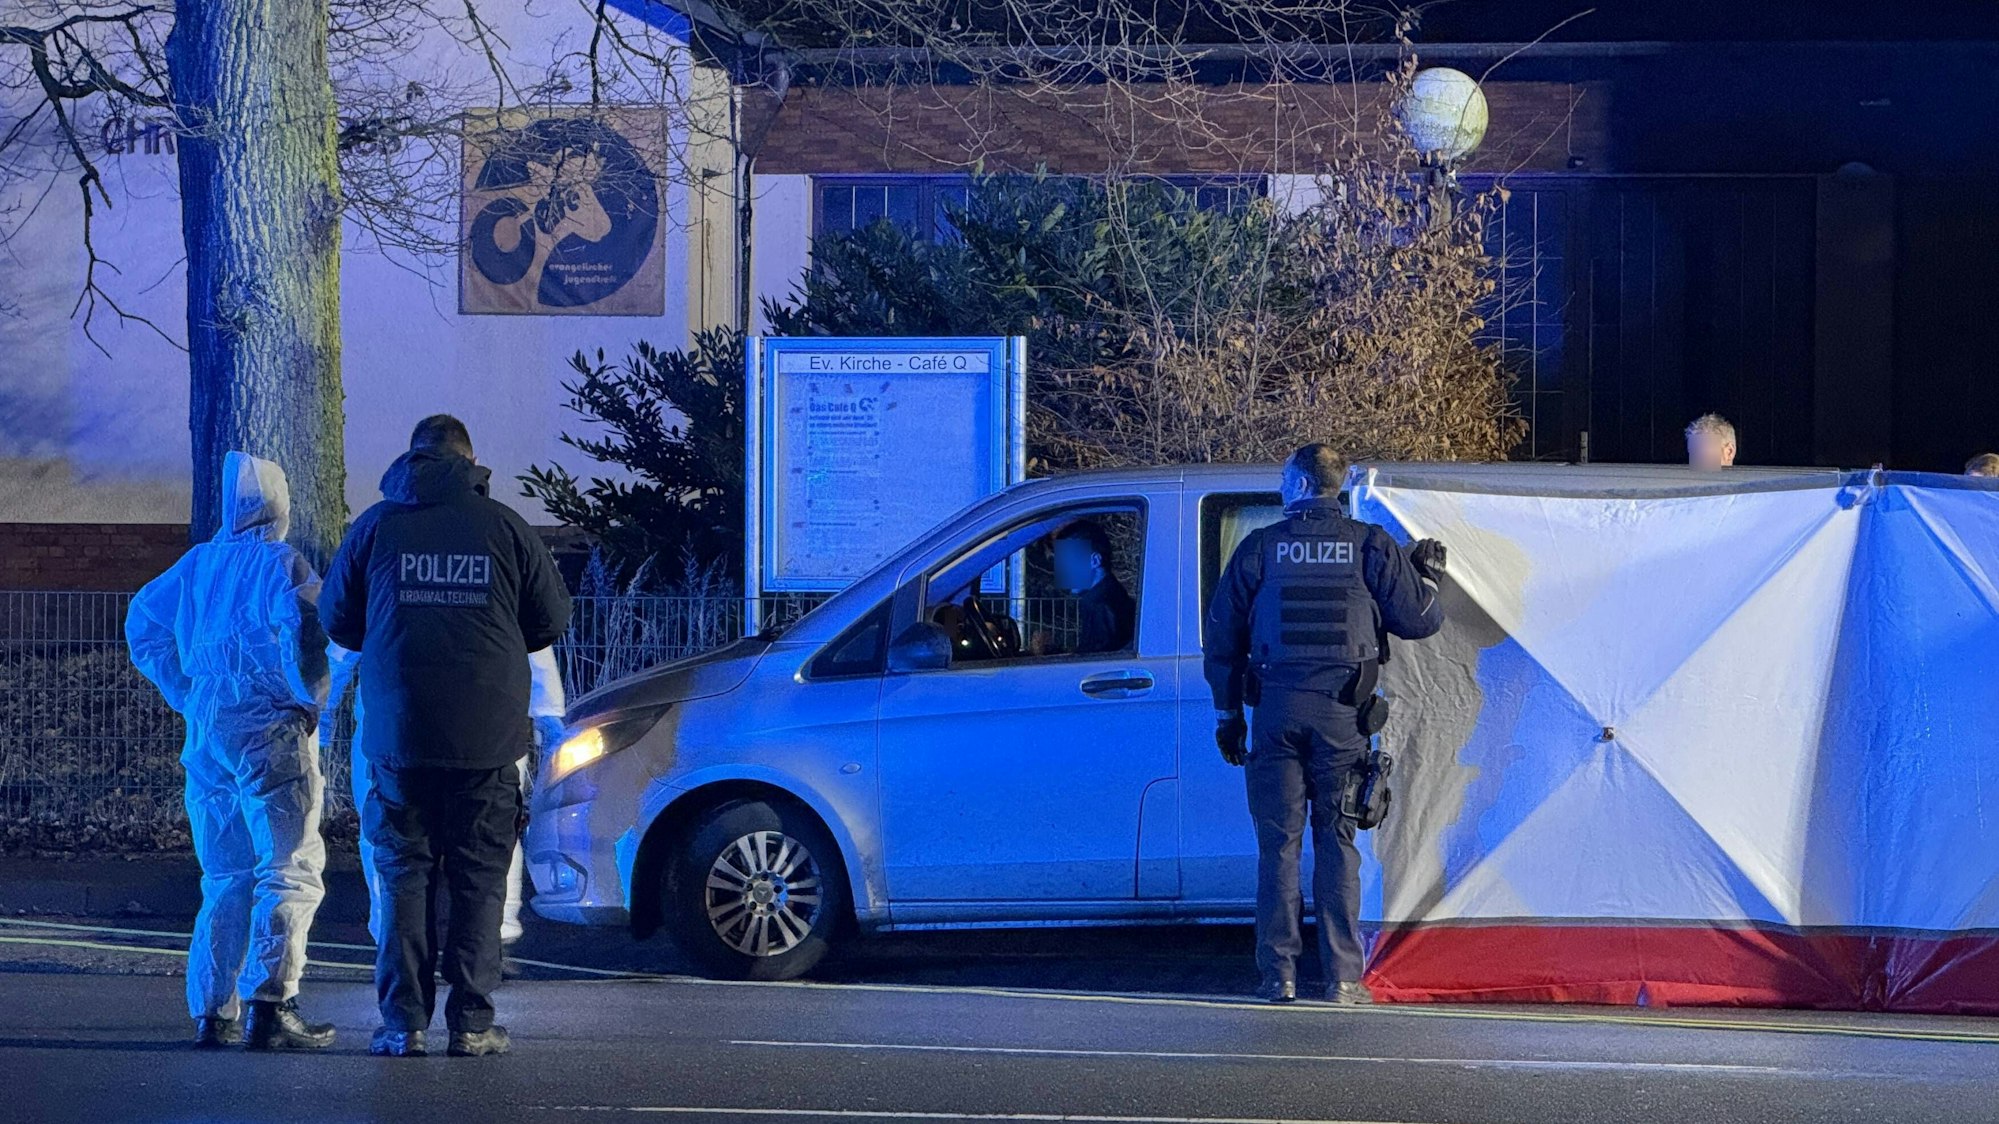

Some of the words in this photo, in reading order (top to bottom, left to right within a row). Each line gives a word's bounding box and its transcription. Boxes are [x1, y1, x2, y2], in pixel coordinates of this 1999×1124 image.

[810, 356, 833, 370] Ev.
[840, 356, 892, 370] Kirche
[909, 355, 947, 370] Café
[953, 355, 967, 370] Q
[1276, 541, 1354, 564] POLIZEI
[400, 553, 490, 584] POLIZEI
